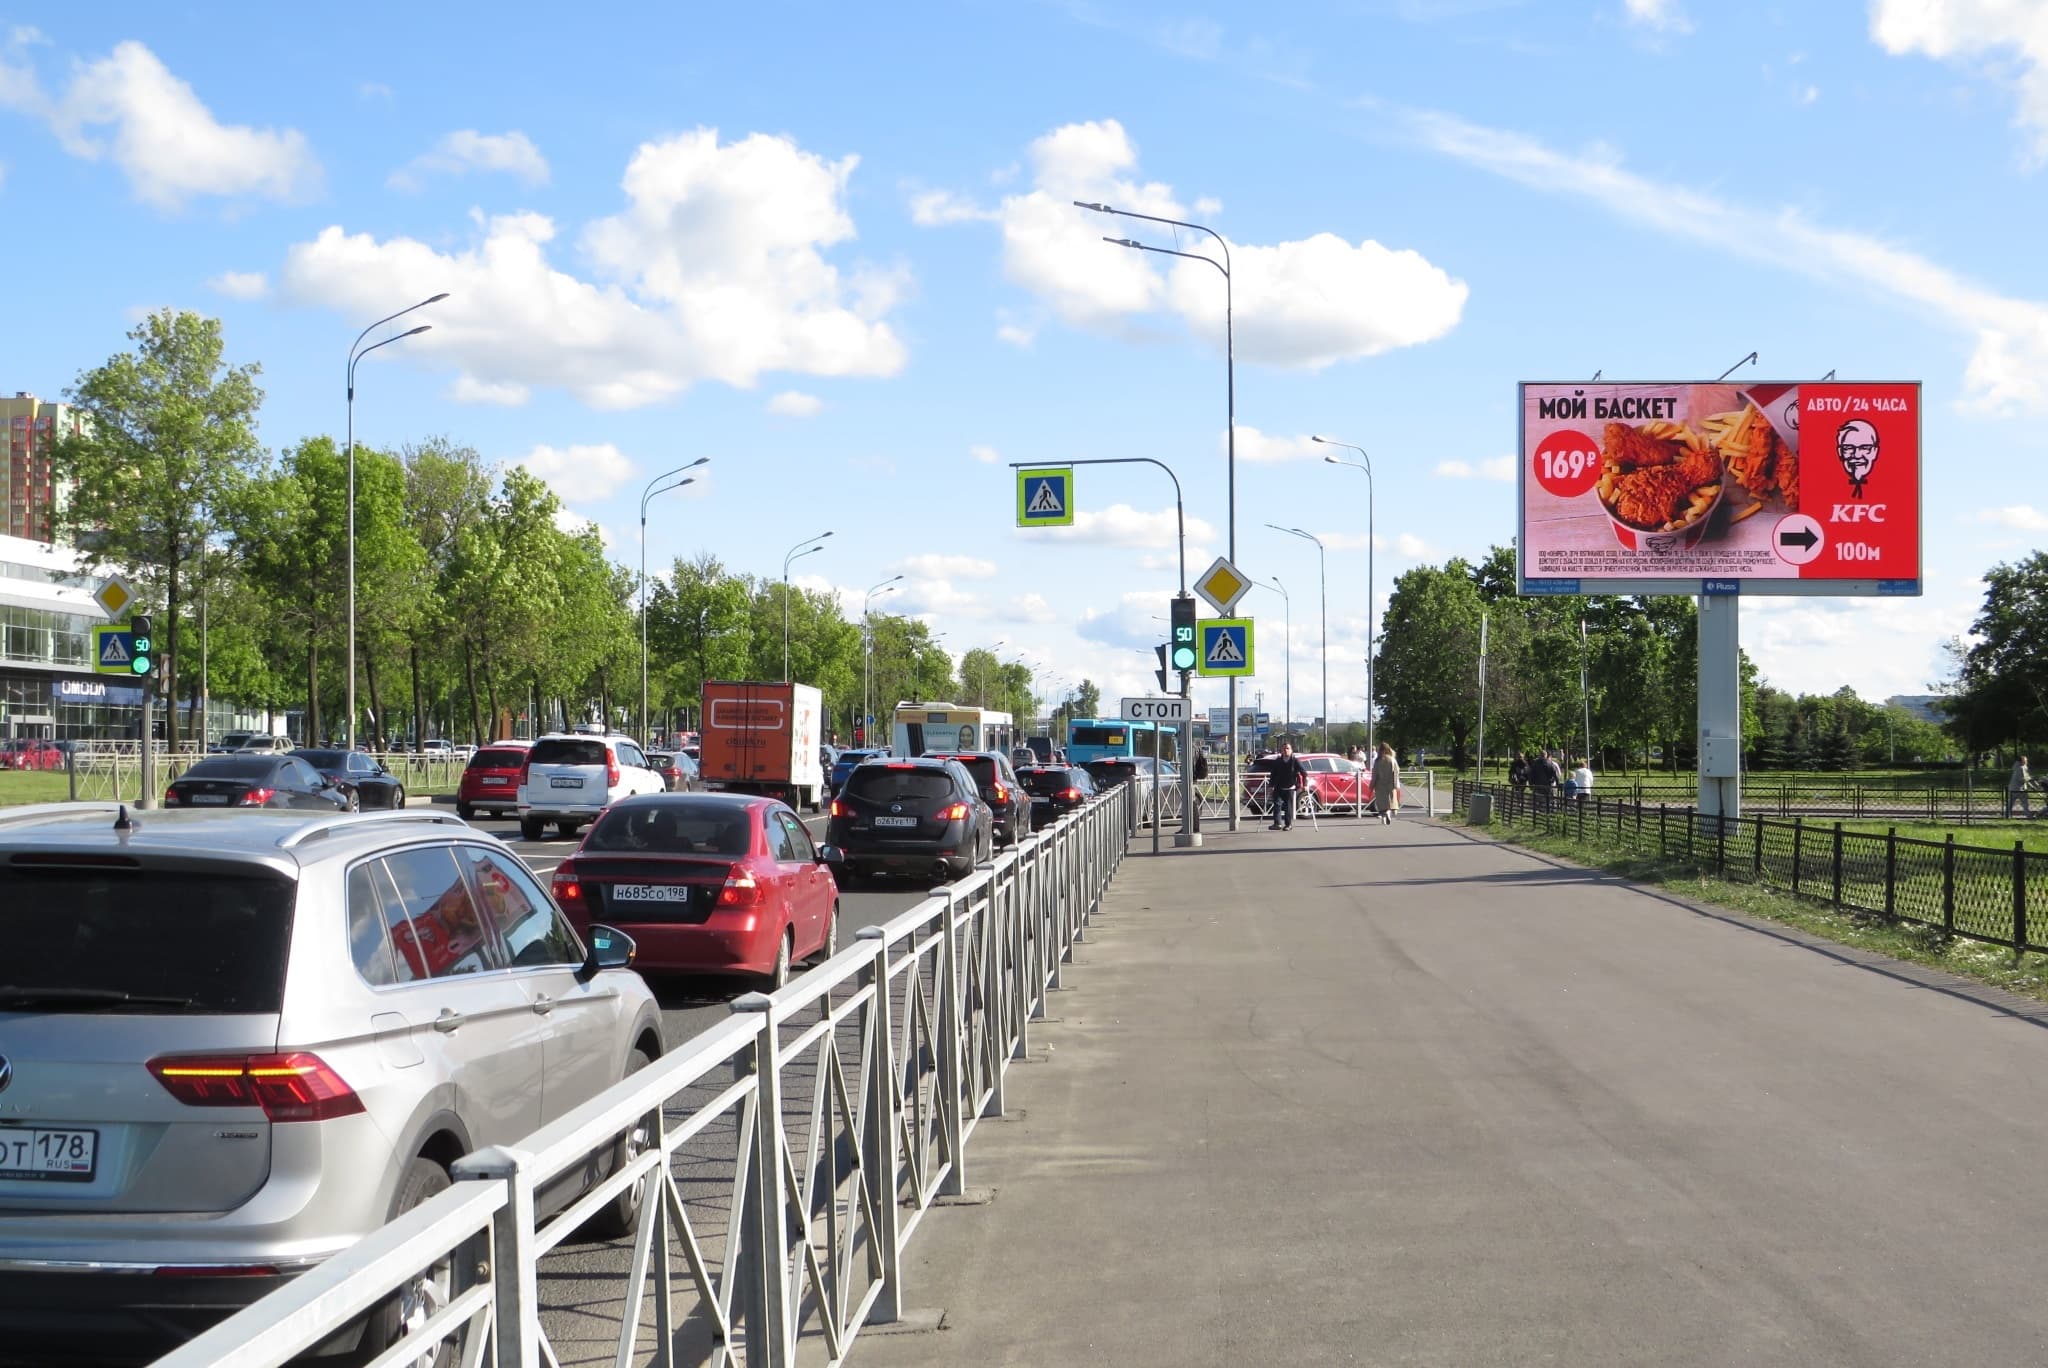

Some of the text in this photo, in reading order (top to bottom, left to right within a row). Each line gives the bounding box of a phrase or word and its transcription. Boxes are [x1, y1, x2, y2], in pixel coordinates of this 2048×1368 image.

[1539, 390, 1677, 419] МОЙ БАСКЕТ
[1873, 396, 1908, 412] ЧАСА
[1829, 504, 1887, 523] KFC
[1715, 582, 1737, 591] Russ
[1176, 627, 1192, 642] 50
[61, 680, 106, 697] OMODA
[1131, 701, 1183, 718] СТОП
[38, 1133, 84, 1160] 178
[46, 1159, 71, 1169] RUS
